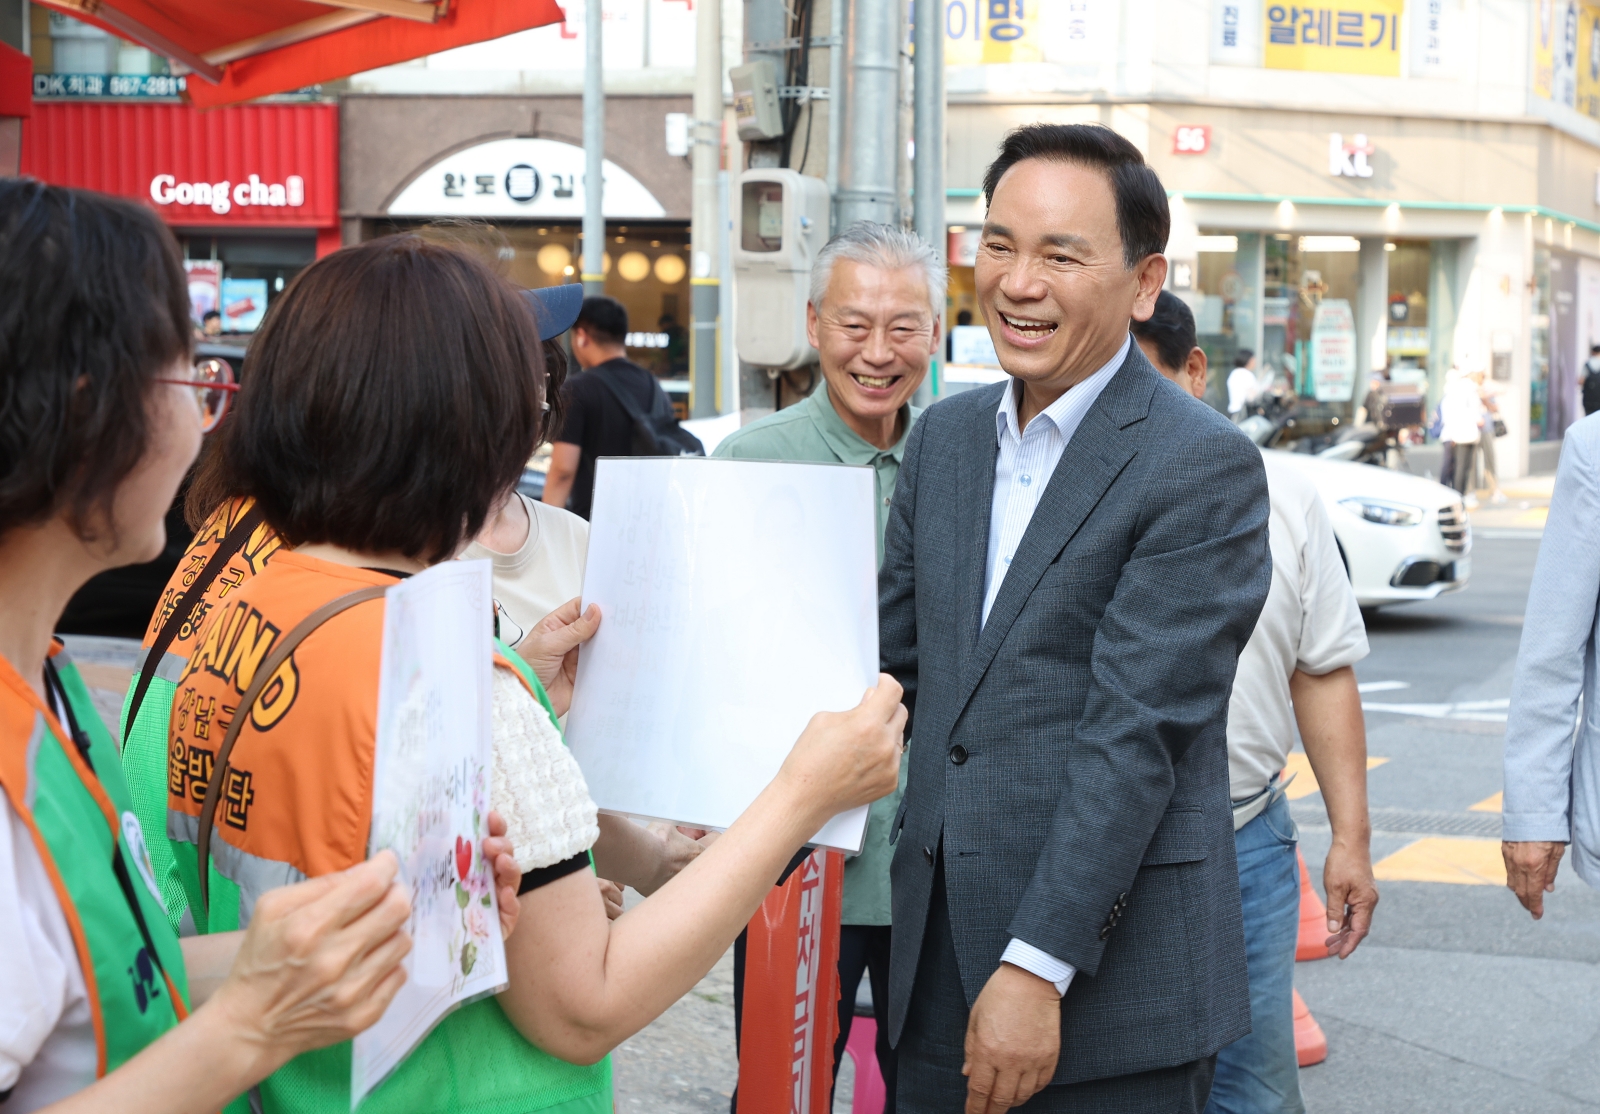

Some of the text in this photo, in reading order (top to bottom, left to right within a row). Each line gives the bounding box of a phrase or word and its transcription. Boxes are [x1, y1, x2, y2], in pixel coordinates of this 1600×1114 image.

[1267, 5, 1397, 51] 알레르기
[33, 75, 67, 96] DK
[68, 76, 105, 96] 치과
[150, 173, 232, 214] Gong
[232, 173, 287, 207] cha
[444, 172, 496, 198] 완도
[183, 555, 246, 599] 강구
